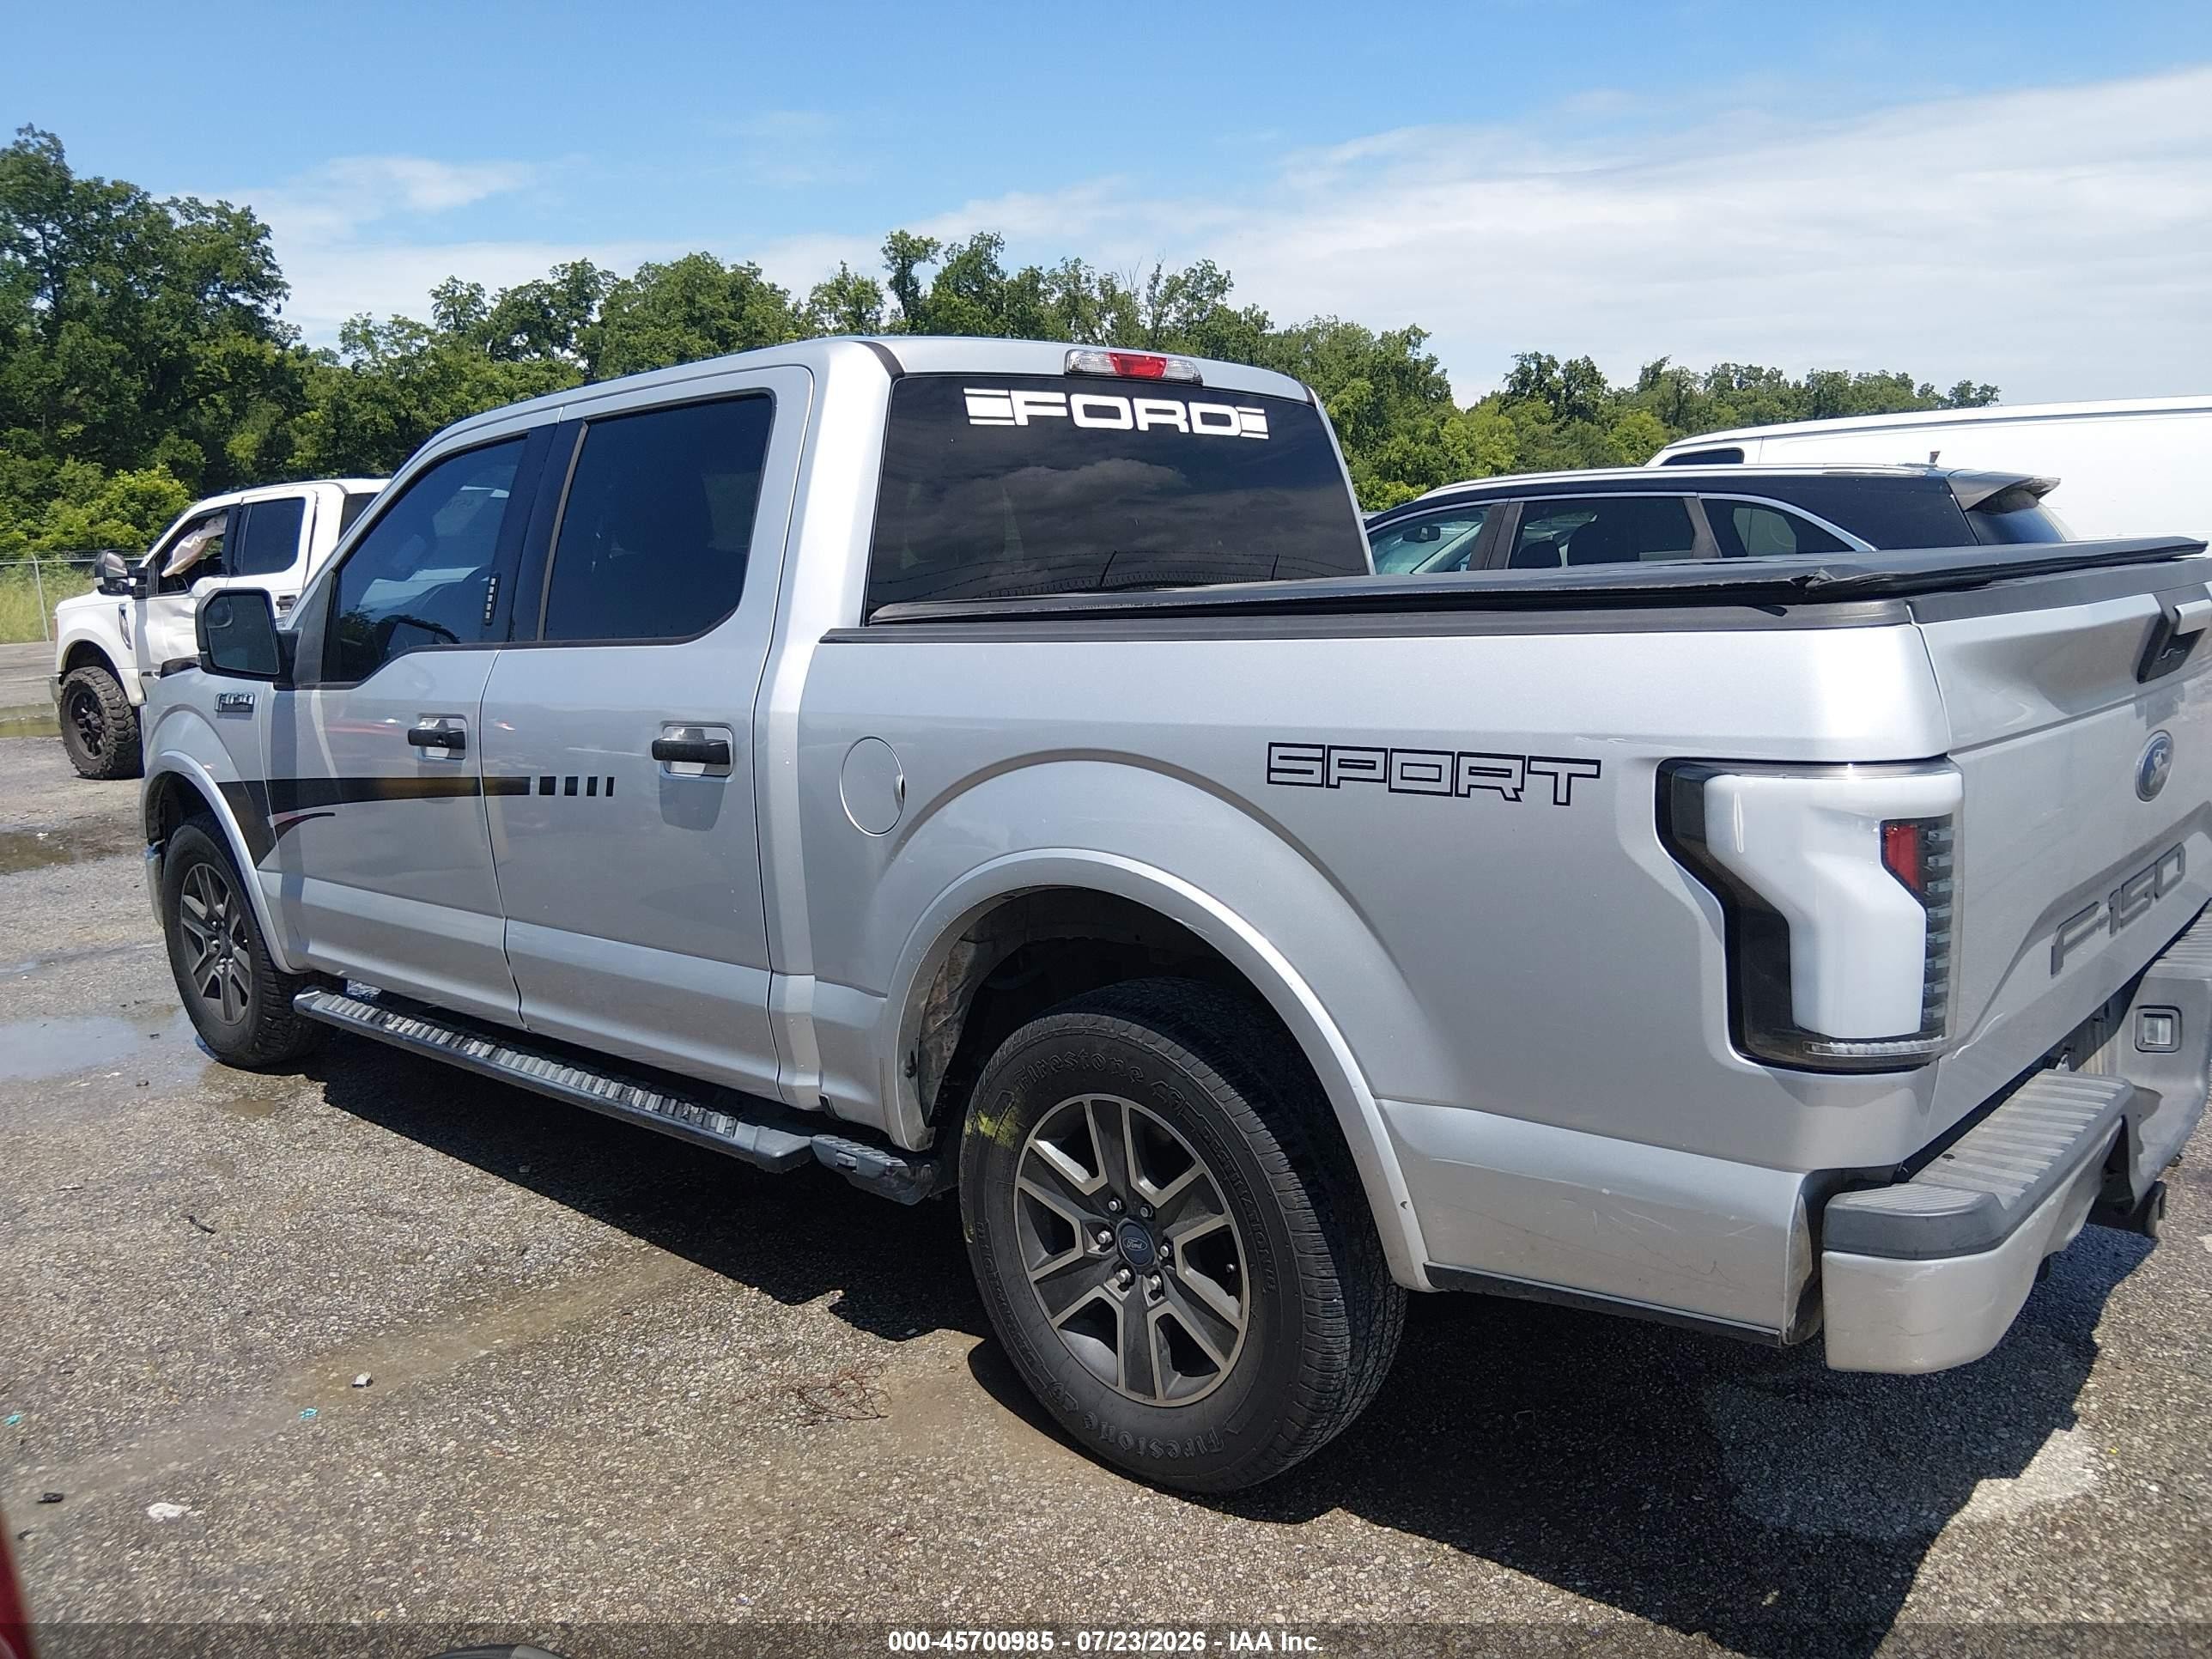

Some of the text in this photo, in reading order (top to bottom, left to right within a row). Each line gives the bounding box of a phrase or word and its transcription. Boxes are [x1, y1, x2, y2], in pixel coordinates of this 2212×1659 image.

[1010, 389, 1243, 436] FORD
[1267, 741, 1601, 806] SPORT
[2051, 841, 2186, 976] F-150
[1015, 1048, 1145, 1093] Firestone
[1084, 1411, 1224, 1458] Firestone
